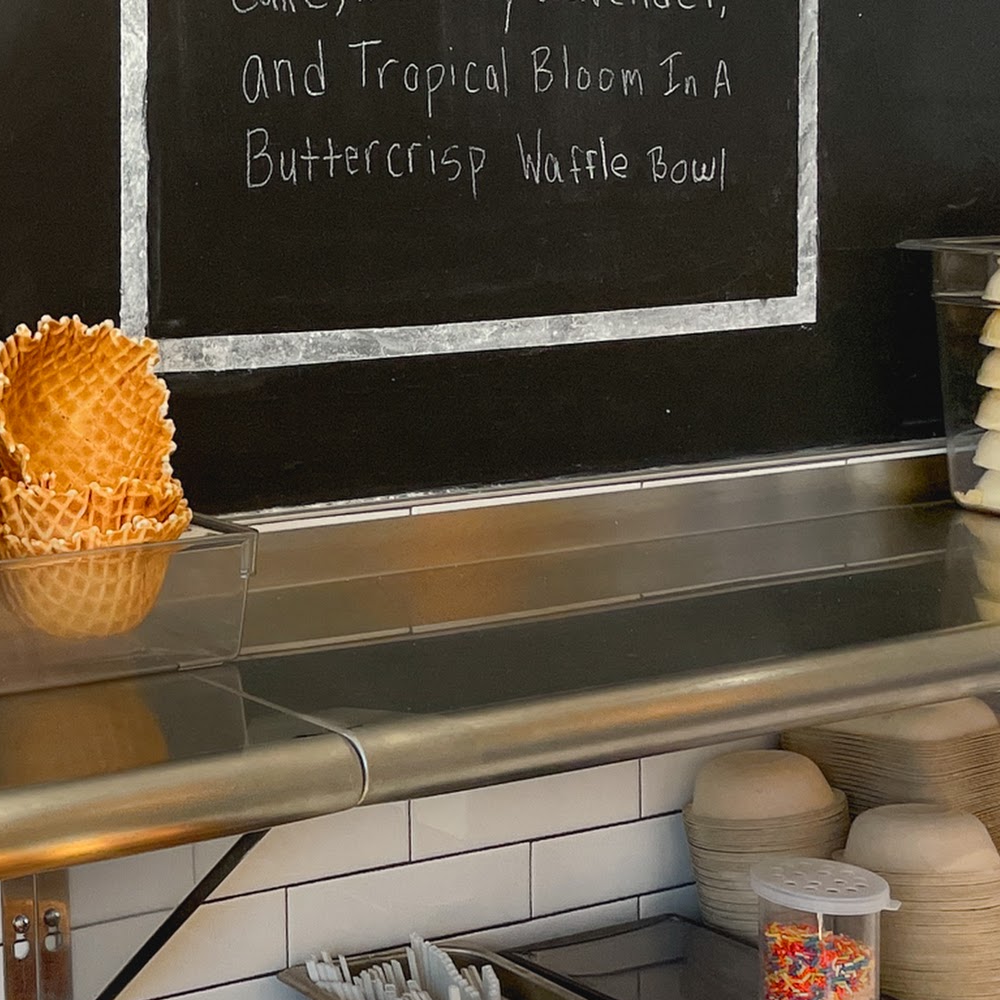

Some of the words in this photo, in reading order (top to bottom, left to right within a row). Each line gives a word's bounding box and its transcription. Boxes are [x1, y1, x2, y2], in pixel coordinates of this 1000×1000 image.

[242, 39, 326, 104] and
[348, 39, 508, 118] Tropical
[530, 45, 644, 96] Bloom
[659, 51, 698, 97] In
[712, 58, 732, 99] A
[245, 127, 487, 196] Buttercrisp
[515, 129, 629, 186] Waffle
[646, 144, 727, 191] Bowl
